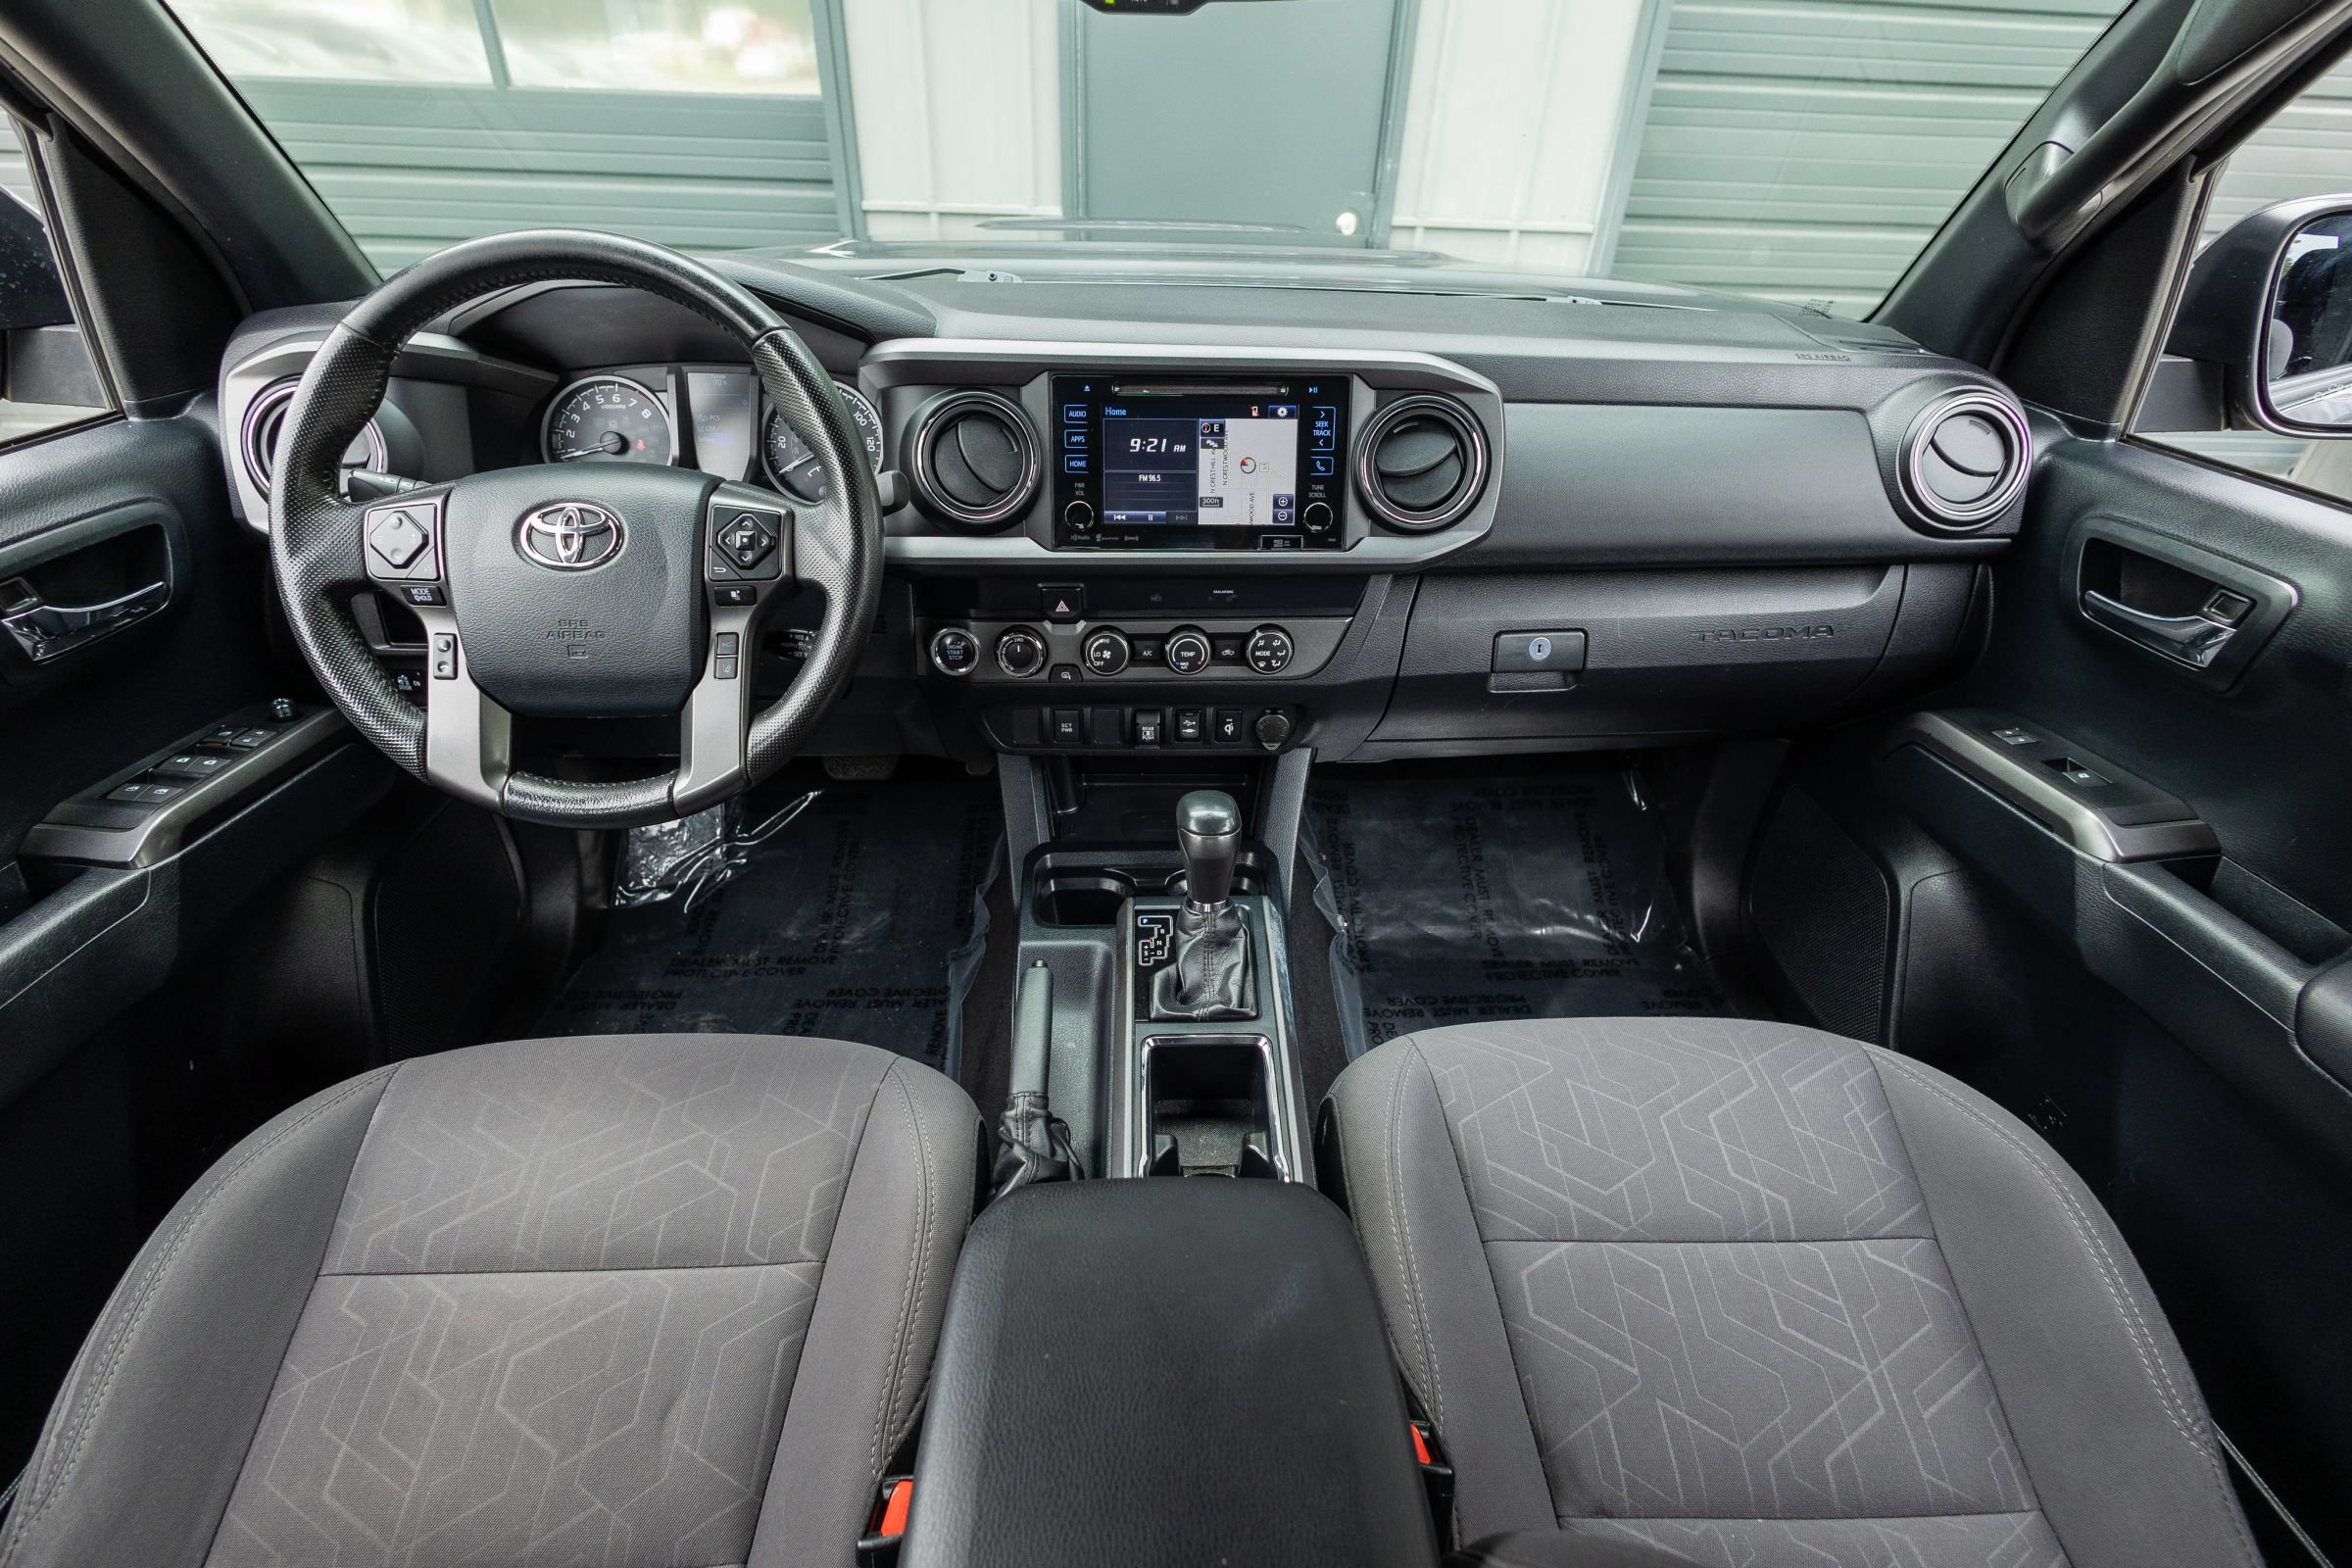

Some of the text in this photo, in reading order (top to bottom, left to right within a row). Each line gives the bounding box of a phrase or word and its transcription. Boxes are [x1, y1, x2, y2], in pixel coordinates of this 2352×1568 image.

[595, 394, 605, 405] 5
[612, 393, 621, 404] 6
[627, 397, 638, 408] 7
[582, 401, 591, 412] 4
[1104, 407, 1127, 416] Home
[570, 413, 581, 424] 3
[641, 408, 652, 419] 8
[853, 411, 868, 426] 100
[1213, 423, 1220, 432] E
[565, 429, 576, 439] 2
[777, 435, 787, 450] 20
[865, 435, 876, 452] 120
[1129, 438, 1187, 453] 9:21 AM
[1690, 624, 1835, 643] TACOMA
[1593, 835, 1613, 879] COVER
[1343, 842, 1359, 887] COVER
[1475, 868, 1490, 901] MUST
[1587, 869, 1603, 903] MUST
[1463, 893, 1483, 941] COVER
[755, 965, 807, 978] COVER
[827, 987, 880, 998] COVER
[791, 999, 858, 1008] REMOVE
[865, 999, 904, 1008] MUST
[1387, 996, 1440, 1006] COVER
[1363, 1006, 1425, 1018] REMOVE
[1433, 1006, 1469, 1017] MUST
